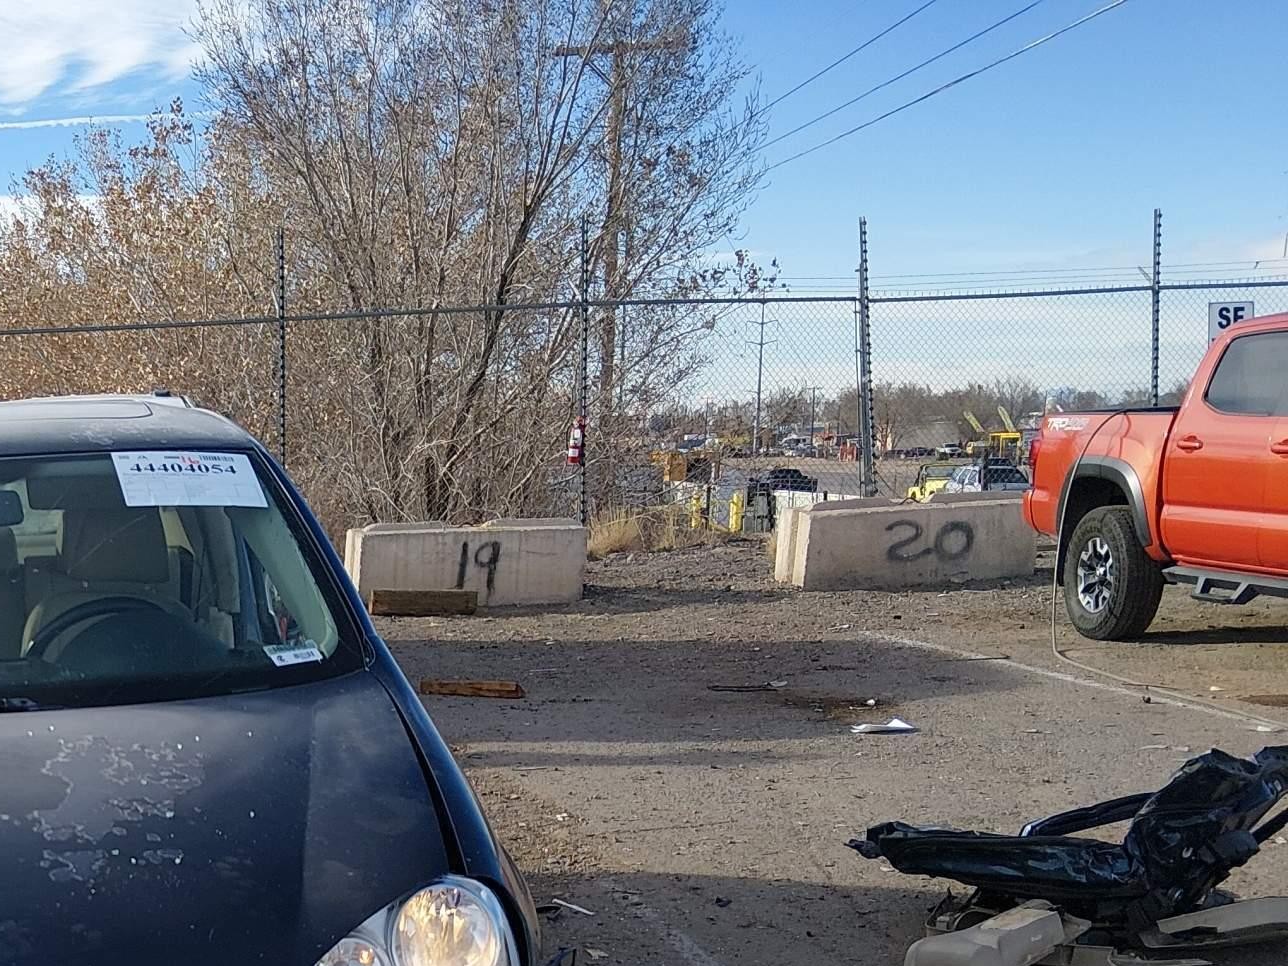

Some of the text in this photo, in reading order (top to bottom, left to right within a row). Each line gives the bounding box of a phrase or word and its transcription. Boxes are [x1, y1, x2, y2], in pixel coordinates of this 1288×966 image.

[130, 462, 237, 475] 44404054
[885, 519, 974, 562] 20
[455, 541, 501, 597] 19
